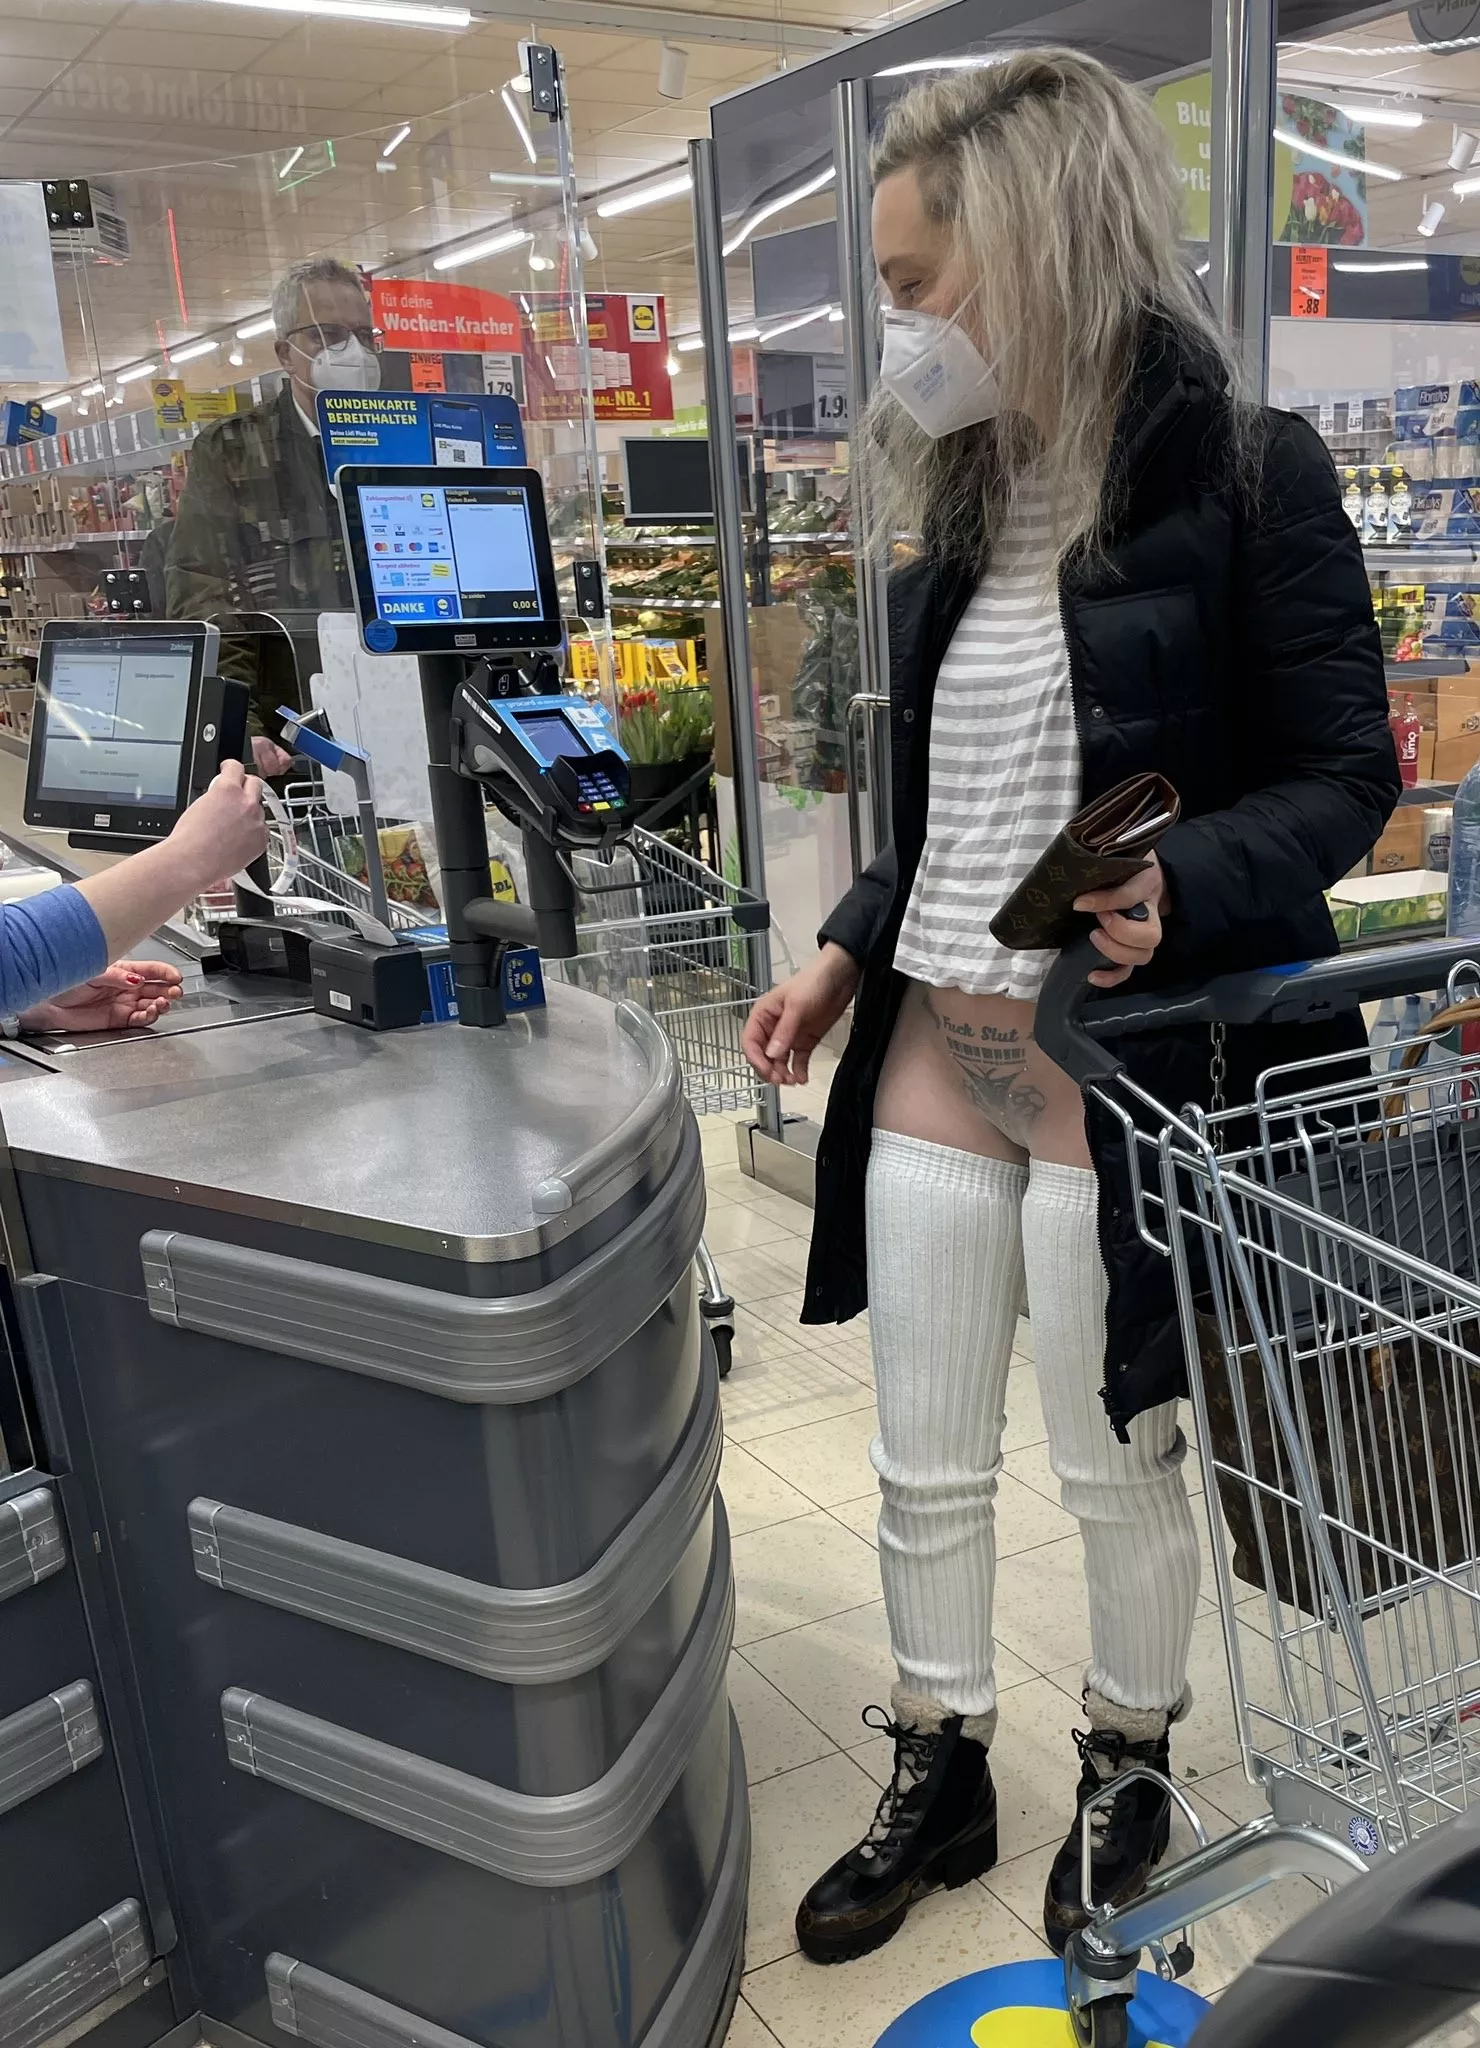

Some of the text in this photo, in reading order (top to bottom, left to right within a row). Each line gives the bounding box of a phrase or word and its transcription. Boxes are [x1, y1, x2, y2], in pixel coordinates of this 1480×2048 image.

[381, 293, 433, 309] für deine
[383, 313, 513, 335] Wochen-Kracher
[487, 382, 513, 396] 179
[325, 398, 417, 411] KUNDENKARTE
[818, 395, 848, 418] 1.9
[327, 413, 417, 425] BEREITHALTEN
[383, 602, 426, 614] DANKE
[512, 601, 531, 609] 0,00
[1407, 732, 1417, 760] Limo
[943, 1015, 1020, 1043] Fuck Slut
